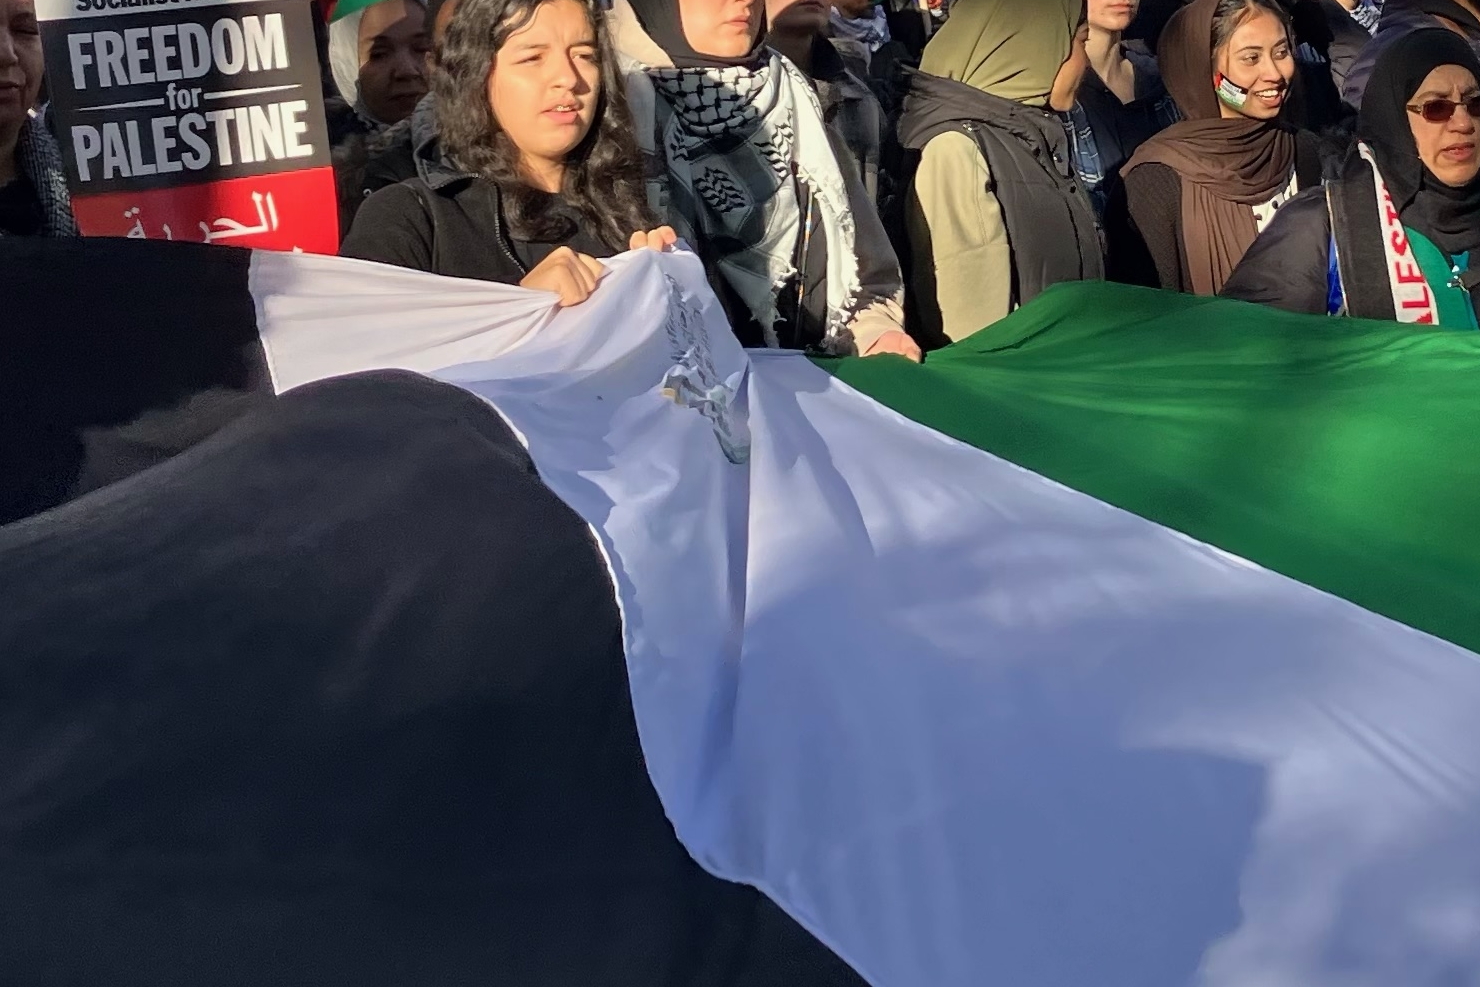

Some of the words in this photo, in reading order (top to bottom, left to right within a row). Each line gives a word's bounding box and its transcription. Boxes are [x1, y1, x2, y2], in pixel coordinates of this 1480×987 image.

[67, 13, 289, 90] FREEDOM
[166, 82, 203, 111] for
[71, 99, 315, 182] PALESTINE
